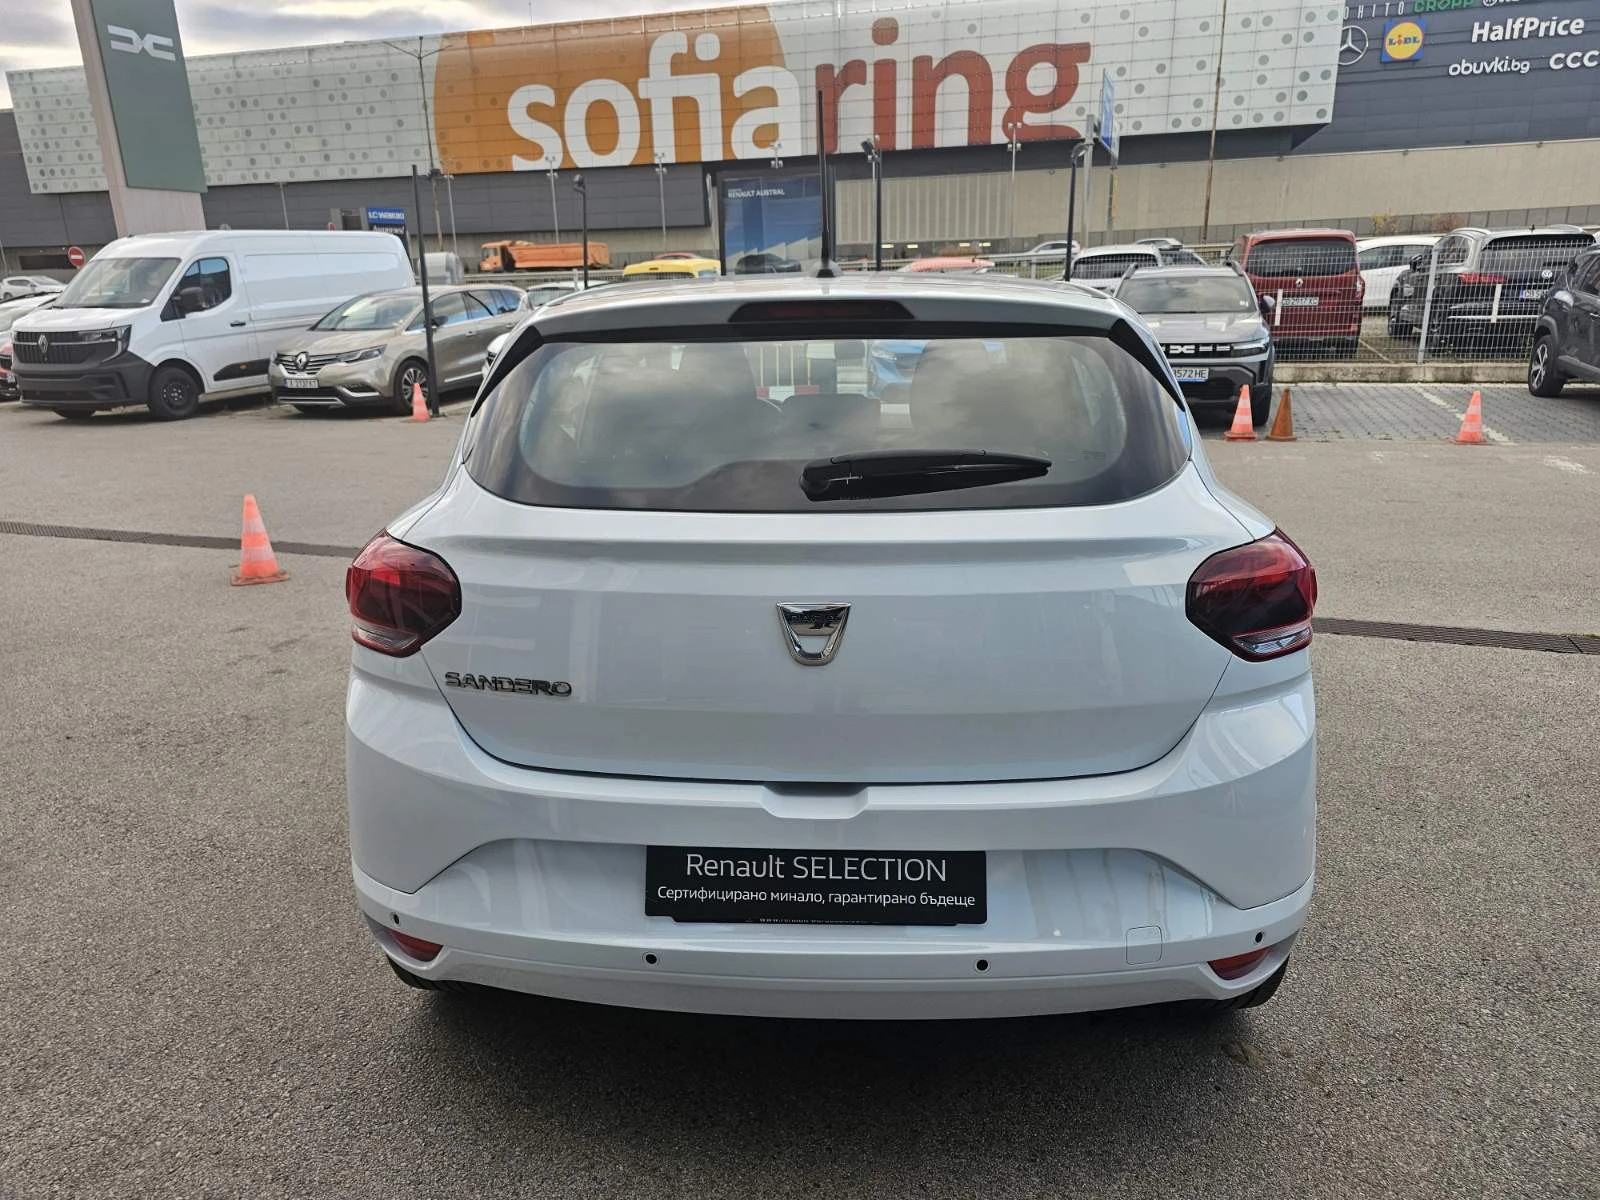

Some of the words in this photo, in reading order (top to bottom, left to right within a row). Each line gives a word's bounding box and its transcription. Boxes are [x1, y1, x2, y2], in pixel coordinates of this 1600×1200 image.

[1471, 16, 1585, 43] HalfPrice
[1448, 56, 1531, 76] obuvki.bg
[727, 189, 755, 198] RENAULT
[756, 188, 785, 197] AUSTRAL
[444, 671, 573, 698] SANDERO
[686, 853, 785, 879] Renault
[793, 856, 946, 882] SELECTION
[657, 886, 767, 903] Сертифицирано
[770, 891, 825, 905] минало,
[828, 893, 917, 907] гарантирано
[920, 892, 976, 908] бъдеще
